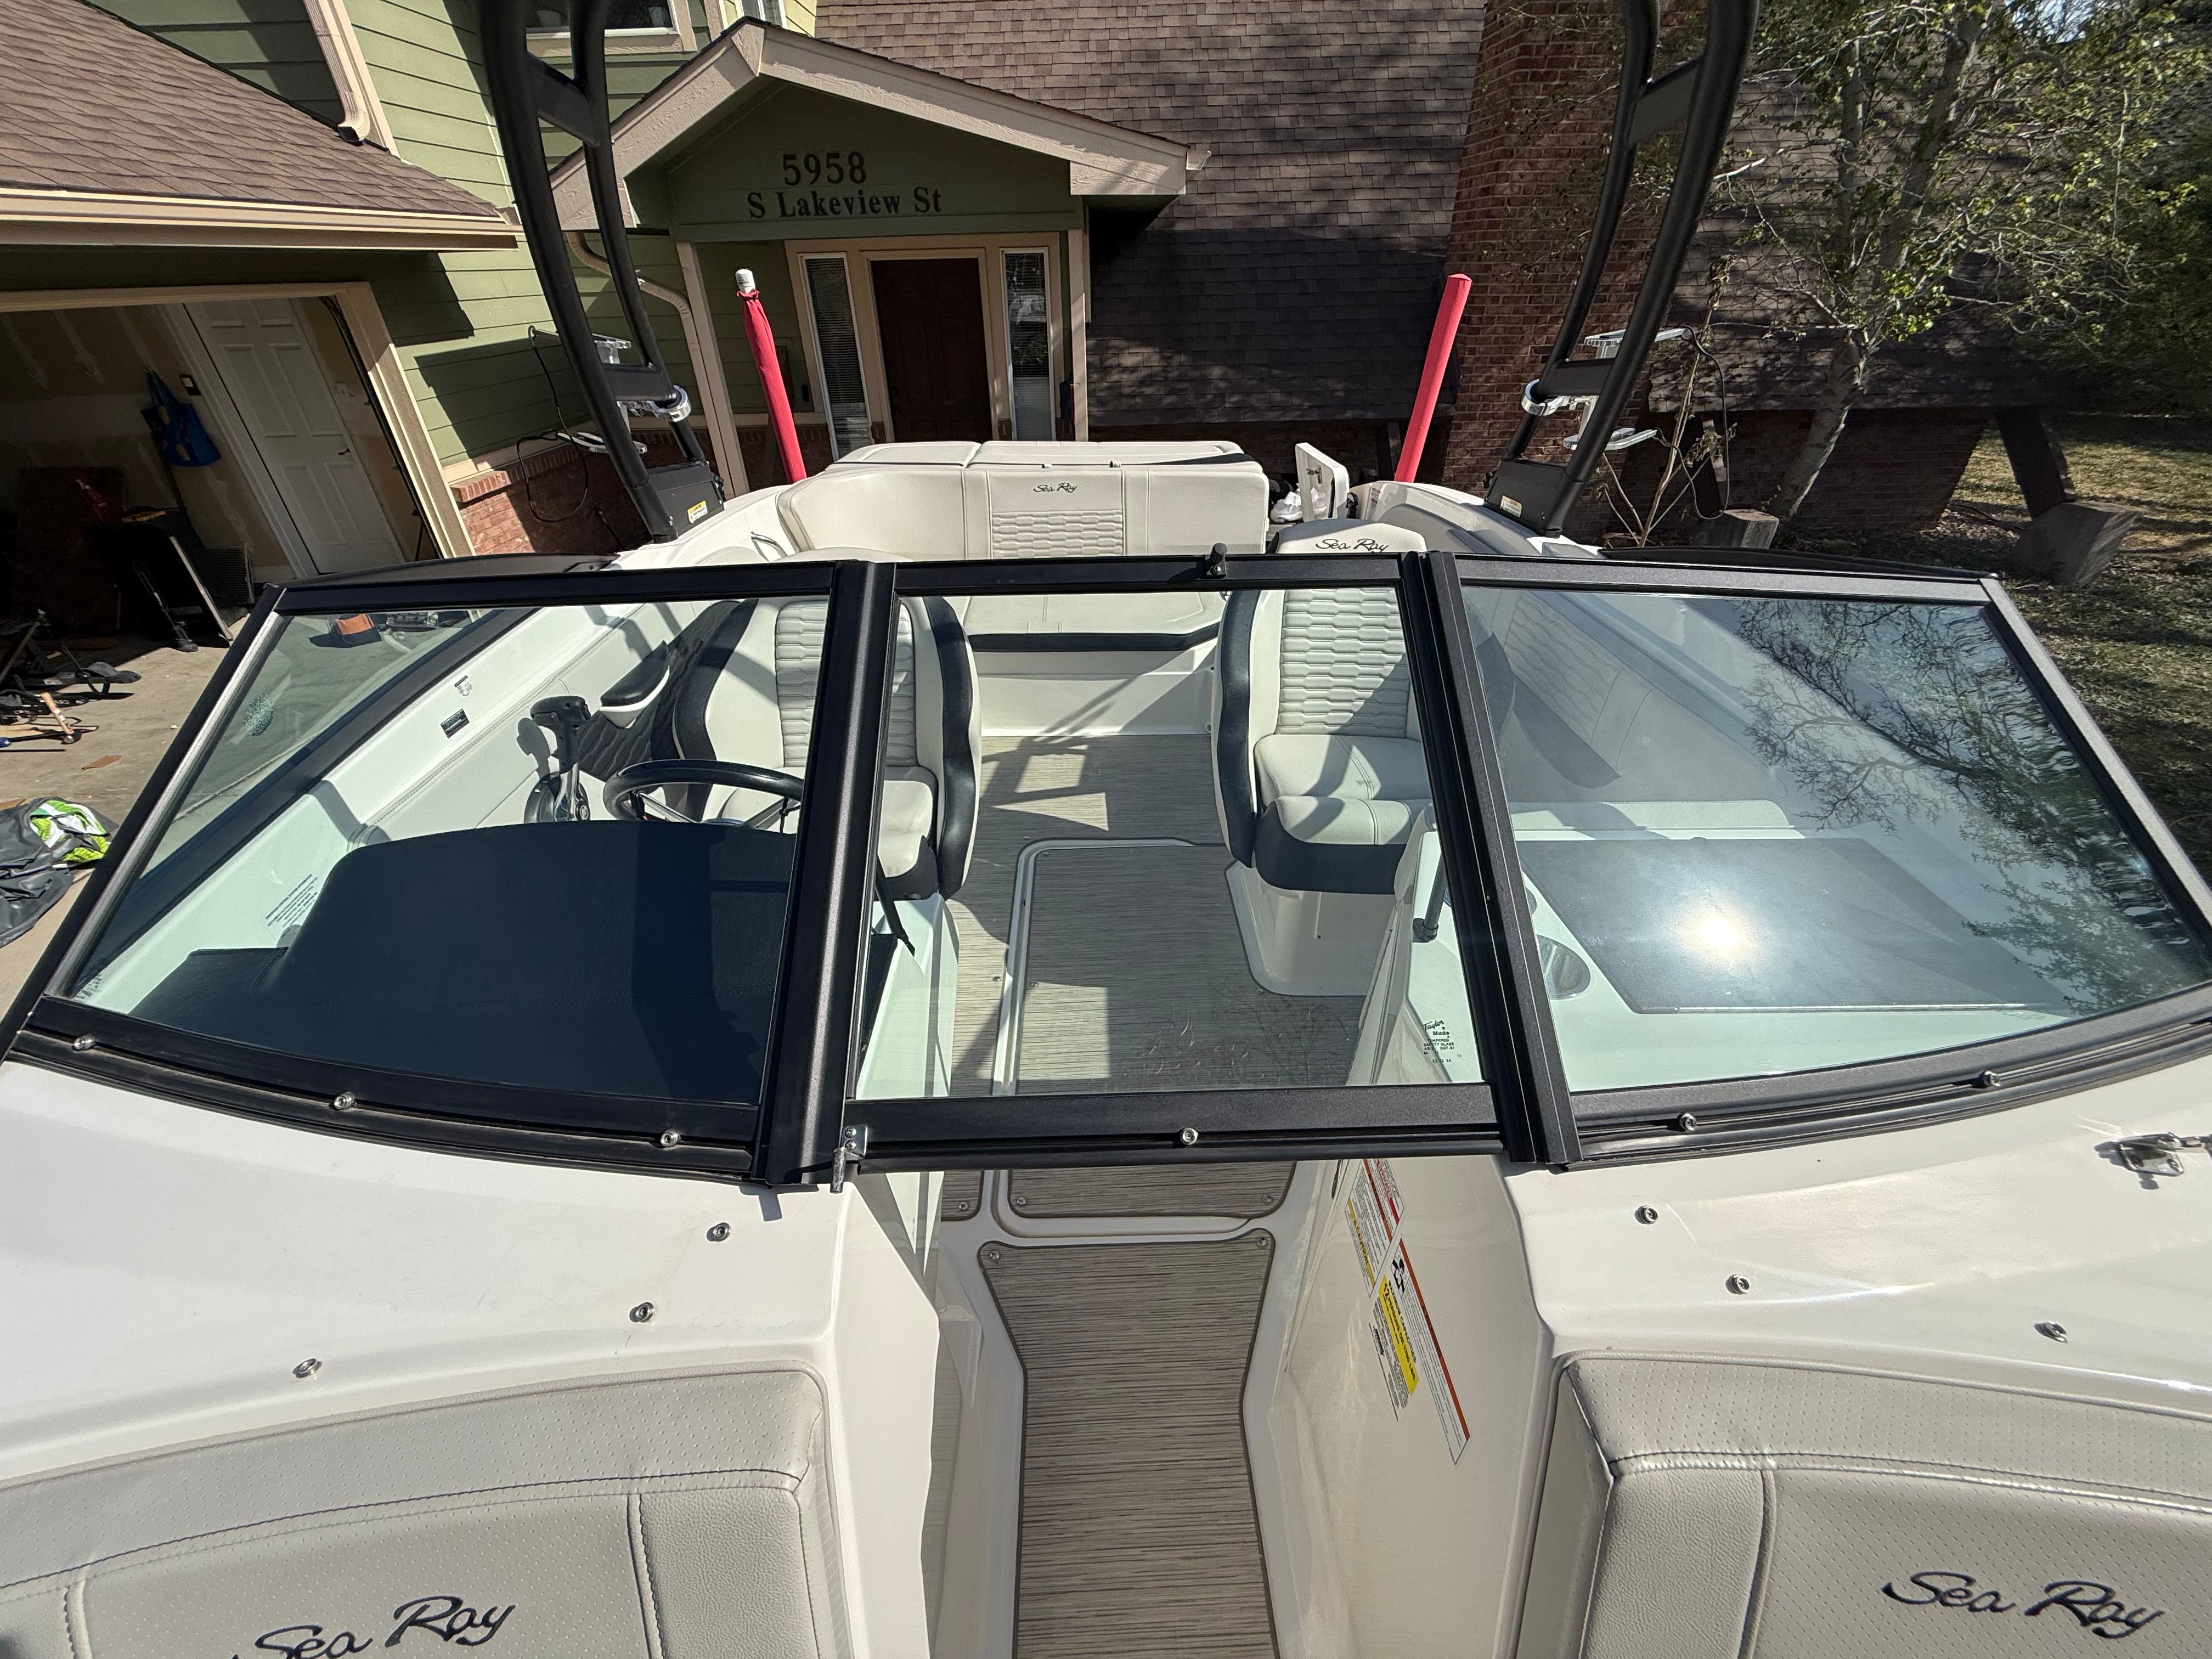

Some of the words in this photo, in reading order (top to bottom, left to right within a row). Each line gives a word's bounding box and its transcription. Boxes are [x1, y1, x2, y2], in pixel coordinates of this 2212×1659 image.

[782, 151, 867, 185] 5958
[747, 192, 765, 218] S
[775, 189, 900, 218] Lakeview
[913, 187, 942, 213] St
[1033, 484, 1055, 493] Sea
[1056, 482, 1078, 493] Ray
[1316, 539, 1351, 550] Sea
[1353, 538, 1389, 552] Ray
[1423, 1020, 1444, 1031] Taylor
[1384, 1283, 1389, 1300] 12
[1388, 1296, 1400, 1333] PERSONS
[1389, 1279, 1401, 1316] MAXIMUM
[1400, 1316, 1416, 1363] CAPACITIES
[1881, 1571, 2016, 1613] Sea
[2024, 1580, 2165, 1639] Ray
[232, 1624, 374, 1659] Sea
[385, 1595, 516, 1647] Ray
